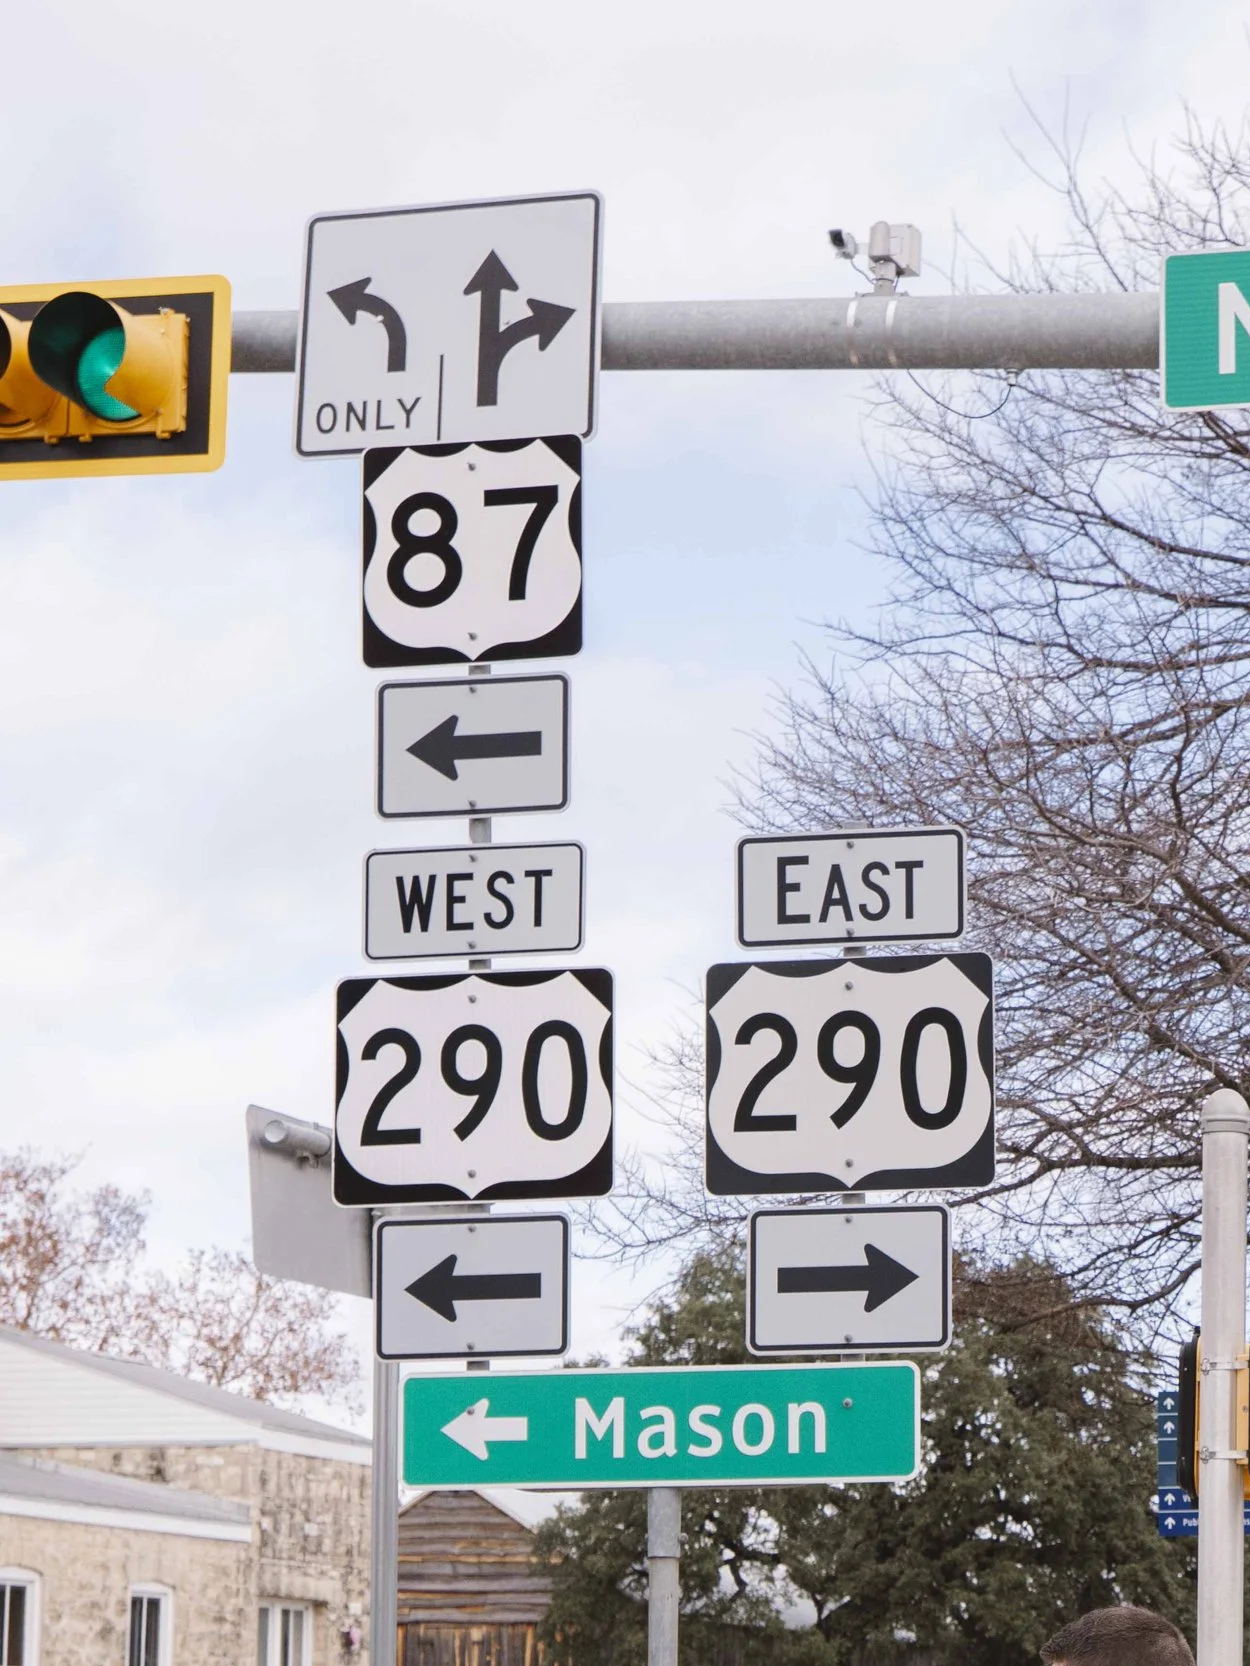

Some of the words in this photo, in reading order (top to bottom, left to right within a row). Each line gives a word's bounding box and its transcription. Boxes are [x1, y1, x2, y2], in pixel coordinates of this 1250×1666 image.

[315, 396, 422, 435] ONLY
[386, 484, 559, 608] 87
[395, 868, 553, 933] WEST
[776, 854, 924, 925] EAST
[360, 1019, 588, 1147] 290
[733, 1007, 968, 1133] 290
[574, 1396, 827, 1460] Mason
